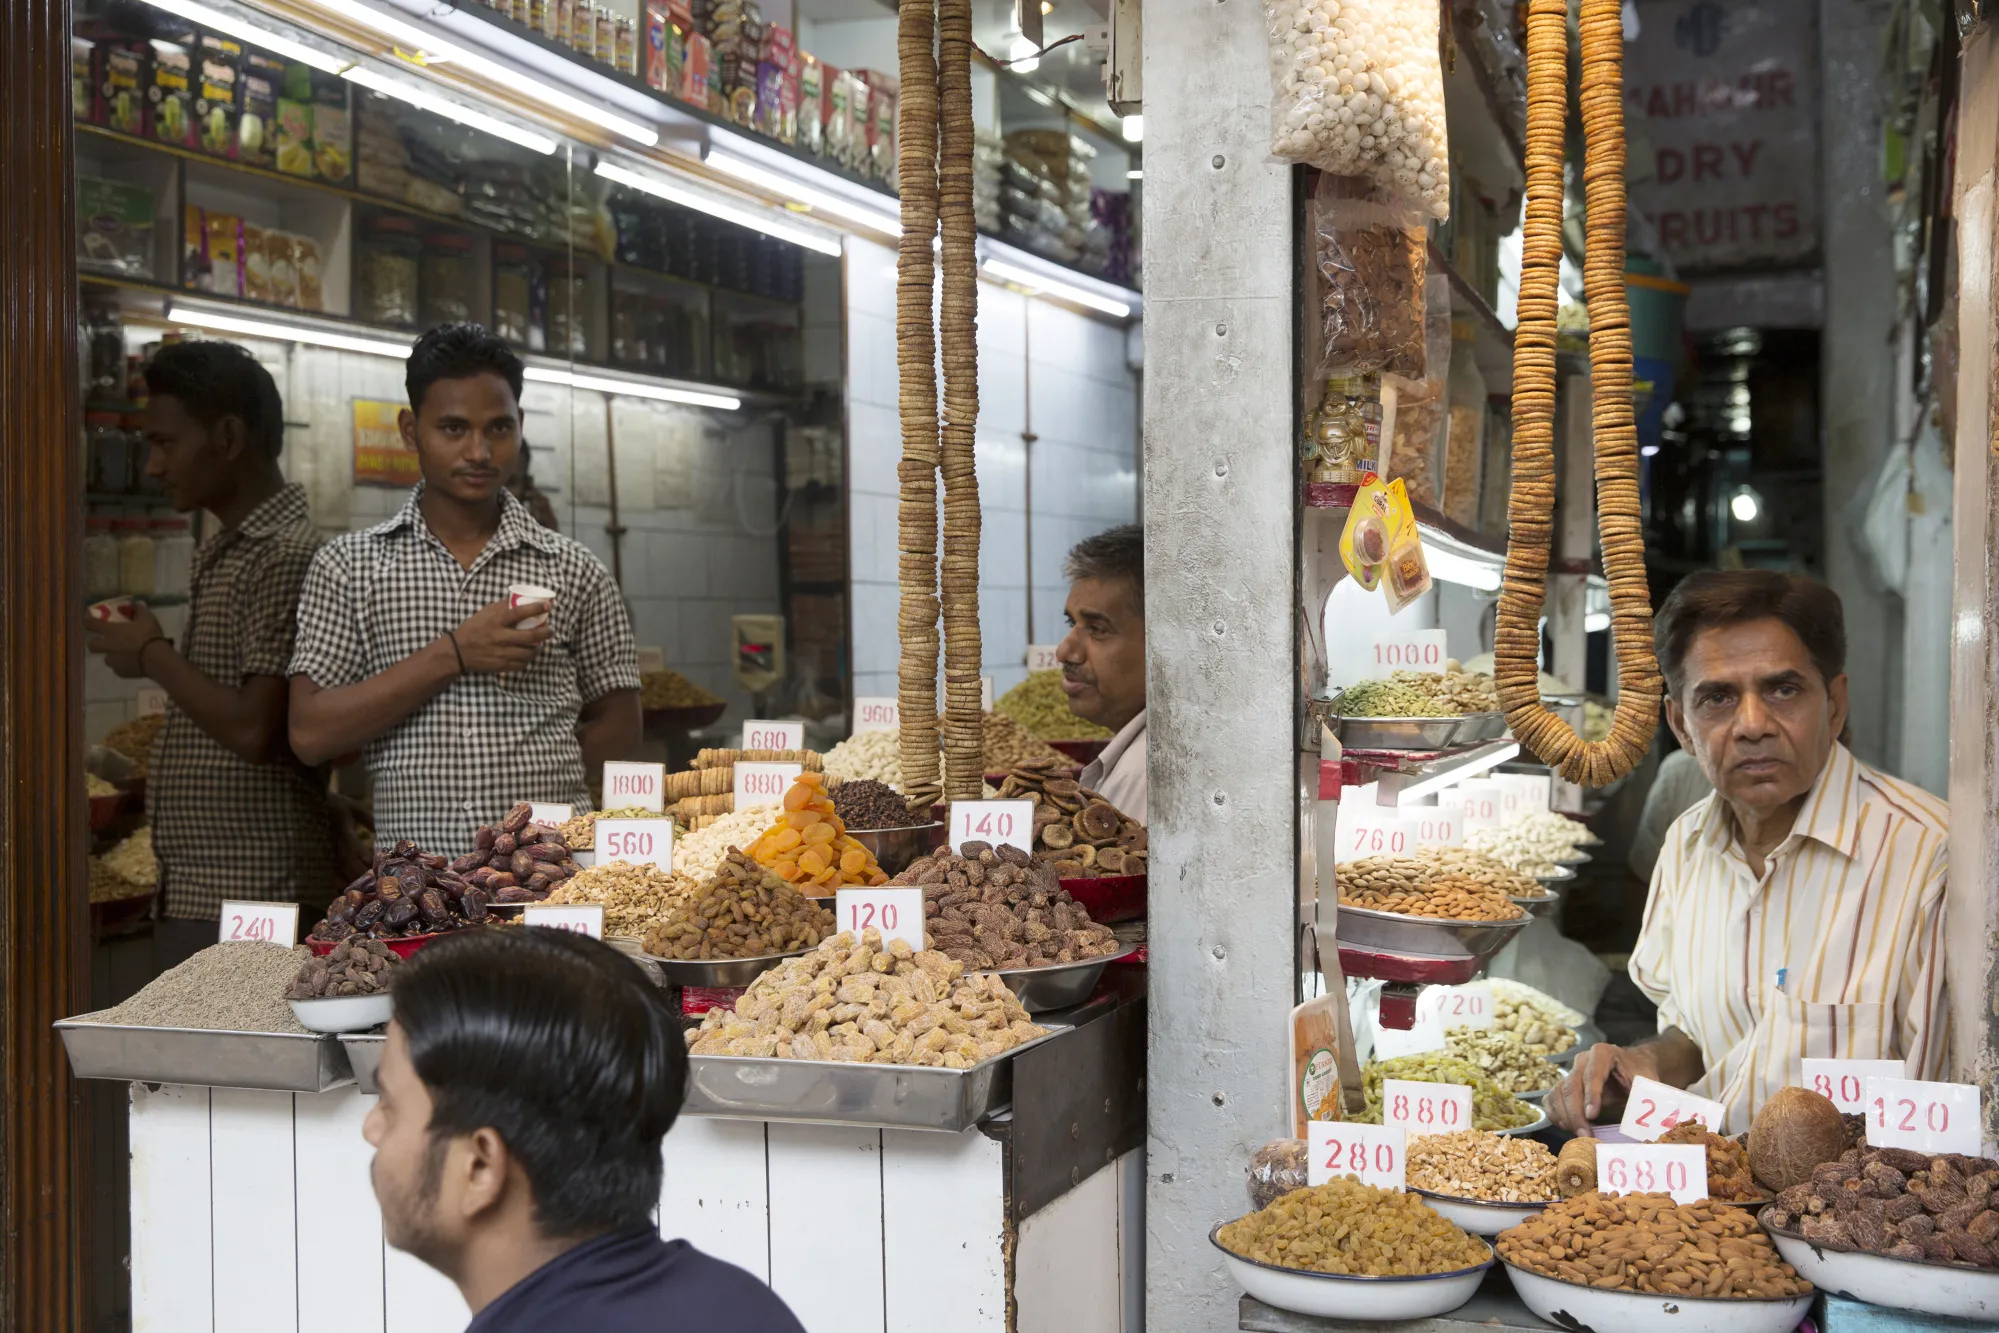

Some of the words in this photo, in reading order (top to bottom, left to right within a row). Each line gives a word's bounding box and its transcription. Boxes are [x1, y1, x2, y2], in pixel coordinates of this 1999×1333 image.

[1656, 139, 1764, 184] DRY
[1356, 460, 1377, 471] MILK
[1037, 652, 1060, 667] 32
[1374, 643, 1439, 665] 1000
[863, 706, 894, 723] 960
[751, 730, 787, 750] 680
[613, 775, 653, 795] 1800
[745, 774, 783, 794] 880
[965, 813, 1012, 837] 140
[608, 832, 653, 857] 560
[1354, 828, 1404, 852] 760
[231, 915, 274, 941] 240
[851, 903, 897, 930] 120
[1437, 994, 1482, 1015] 720
[1815, 1074, 1860, 1102] 80
[1393, 1095, 1458, 1125] 880
[1874, 1097, 1949, 1133] 120
[1325, 1139, 1394, 1173] 280
[1607, 1157, 1687, 1191] 680
